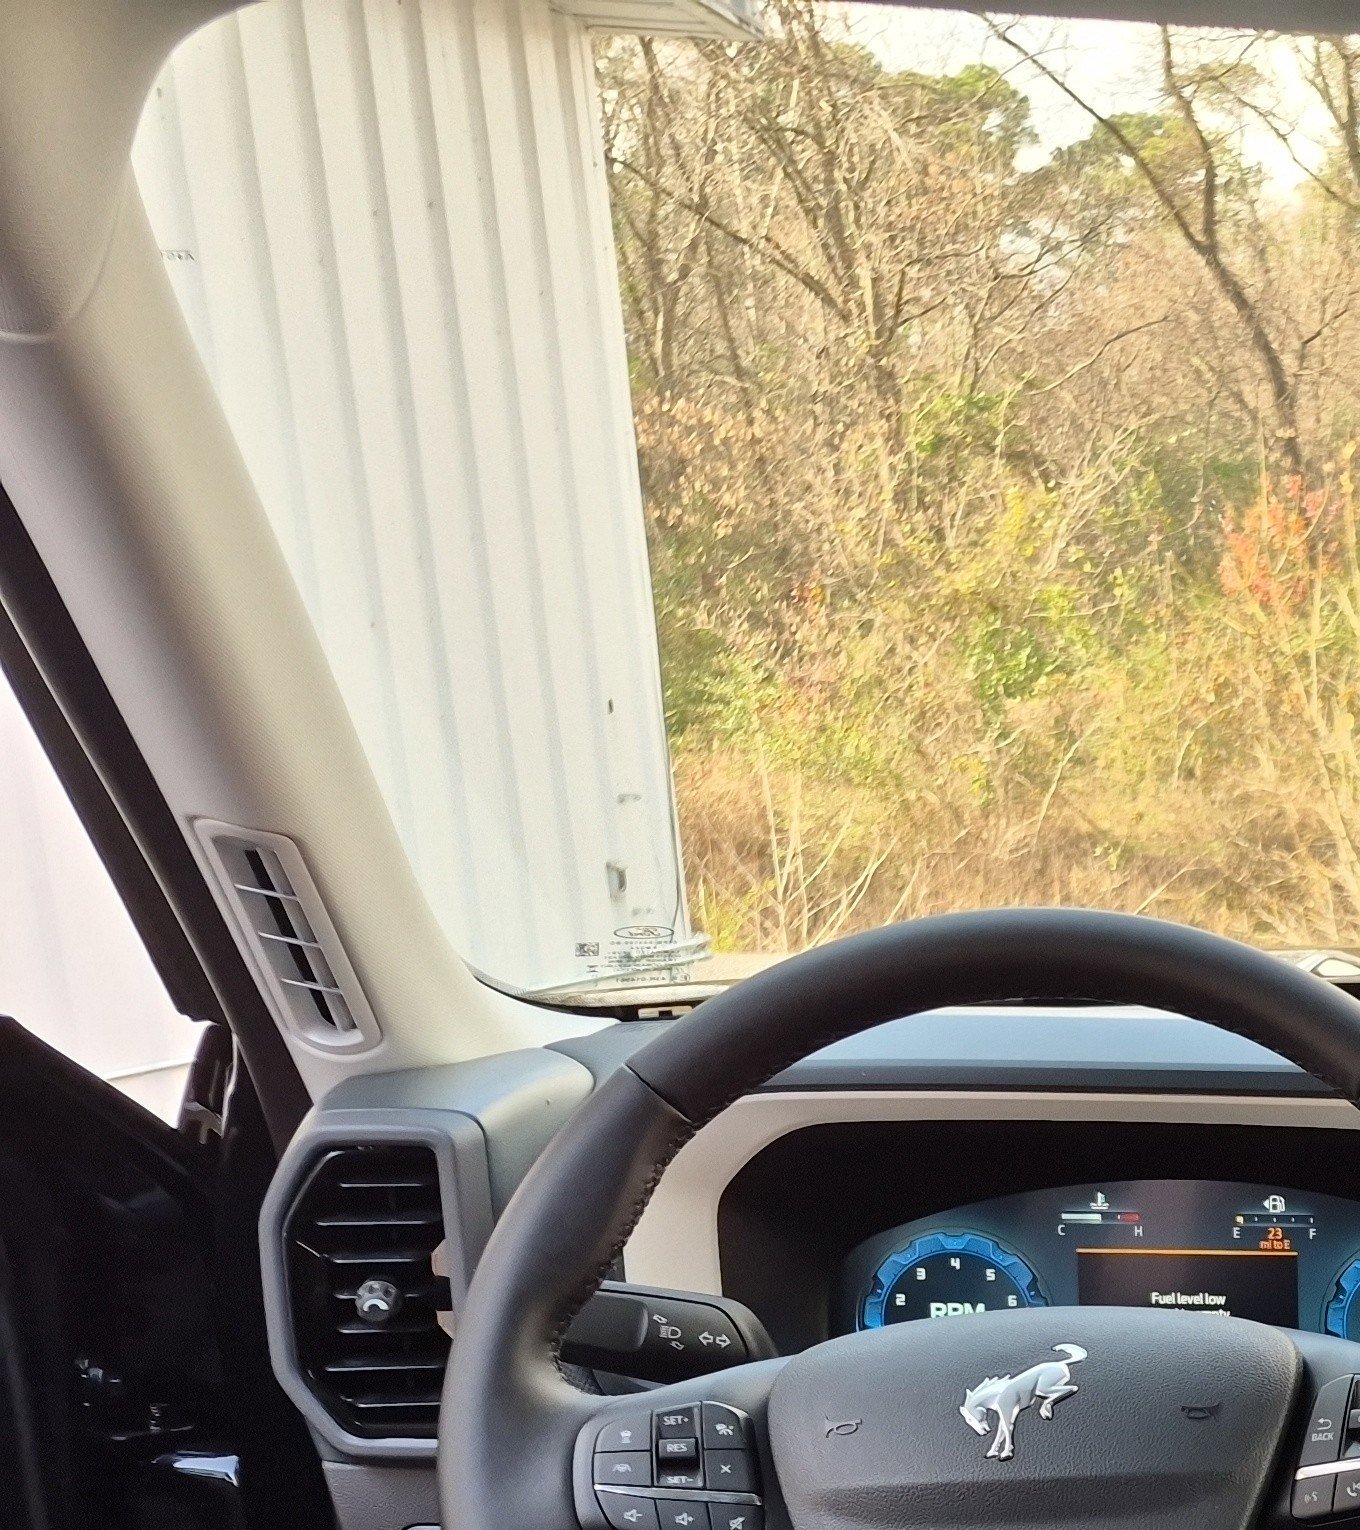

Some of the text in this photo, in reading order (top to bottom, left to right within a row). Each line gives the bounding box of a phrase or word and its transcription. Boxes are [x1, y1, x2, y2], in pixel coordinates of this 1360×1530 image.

[1057, 1224, 1066, 1236] C
[1134, 1226, 1143, 1237] H
[1233, 1227, 1241, 1239] E
[1267, 1227, 1283, 1240] 23
[1309, 1228, 1317, 1240] F
[1273, 1240, 1284, 1250] to
[1284, 1240, 1291, 1250] E
[950, 1257, 961, 1270] 4
[916, 1267, 926, 1281] 3
[985, 1268, 996, 1281] 5
[895, 1293, 906, 1306] 2
[1007, 1295, 1018, 1307] 6
[1151, 1291, 1227, 1306] Fuel level low
[1311, 1431, 1335, 1442] BACK
[666, 1443, 688, 1453] RES
